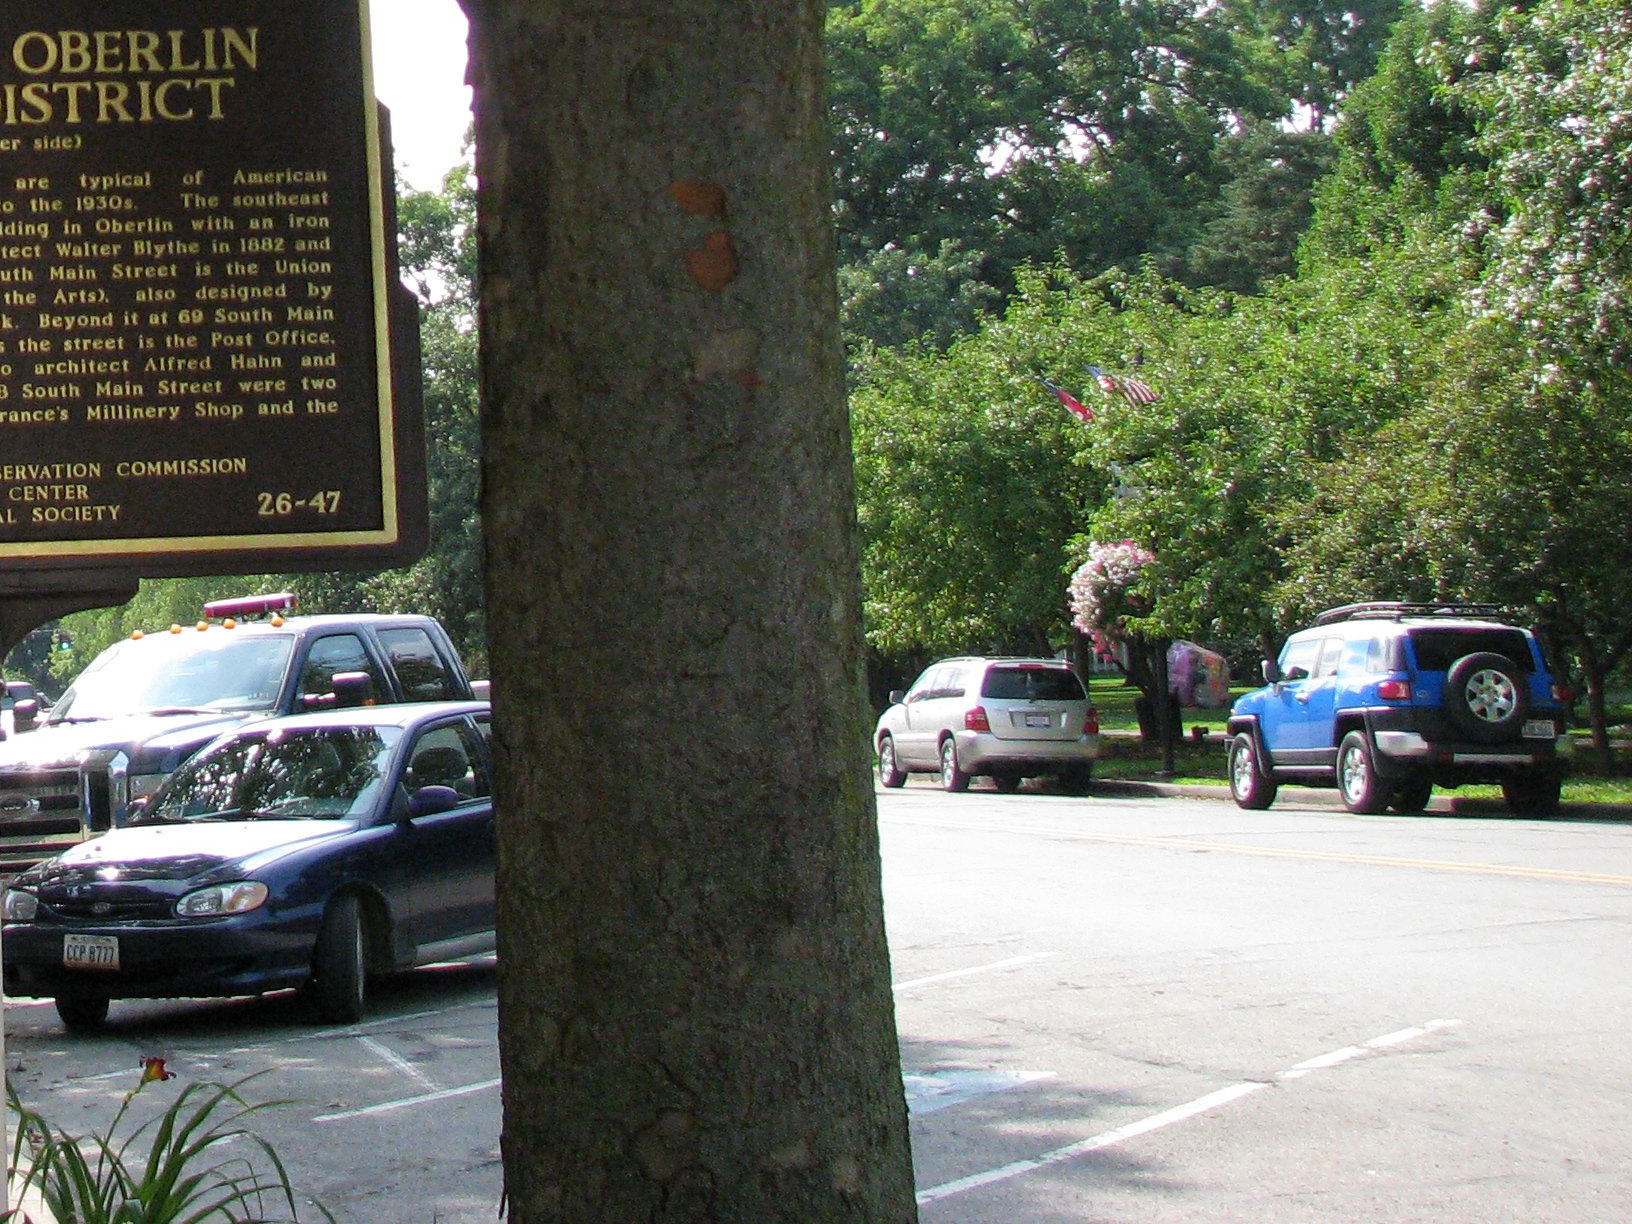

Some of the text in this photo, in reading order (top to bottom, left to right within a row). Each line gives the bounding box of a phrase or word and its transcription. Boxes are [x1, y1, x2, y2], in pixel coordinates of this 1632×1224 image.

[12, 27, 259, 75] OBERLIN
[15, 176, 50, 191] are
[79, 171, 152, 191] typical
[182, 170, 203, 186] of
[233, 167, 328, 185] American
[29, 197, 63, 213] the
[180, 193, 219, 209] The
[233, 190, 329, 207] southeast
[63, 219, 82, 235] in
[95, 217, 173, 234] Oberlin
[191, 215, 235, 231] with
[249, 217, 274, 230] an
[288, 213, 330, 229] iron
[55, 241, 122, 258] Walter
[133, 240, 200, 259] Blythe
[212, 242, 230, 254] in
[295, 235, 331, 252] and
[49, 264, 97, 281] Main
[111, 263, 177, 279] Street
[226, 261, 258, 276] the
[275, 258, 332, 275] Union
[3, 289, 37, 306] the
[135, 286, 176, 302] also
[195, 282, 287, 302] designed
[307, 281, 333, 301] by
[38, 311, 114, 331] Beyond
[177, 308, 204, 324] 69
[214, 307, 273, 324] South
[287, 305, 335, 322] Main
[18, 337, 51, 353] the
[63, 336, 124, 352] street
[165, 333, 198, 349] the
[211, 331, 253, 348] Post
[34, 358, 129, 376] architect
[144, 355, 212, 372] Alfred
[230, 353, 282, 370] Hahn
[300, 352, 337, 368] and
[22, 382, 81, 399] South
[96, 380, 144, 397] Main
[157, 379, 222, 396] Street
[238, 379, 286, 393] were
[301, 376, 337, 391] two
[86, 404, 181, 421] Millinery
[194, 401, 244, 421] Shop
[258, 399, 295, 416] and
[306, 398, 339, 414] the
[116, 457, 247, 477] COMMISSION
[8, 484, 89, 502] CENTER
[257, 489, 342, 517] 26-47
[31, 504, 121, 523] SOCIETY
